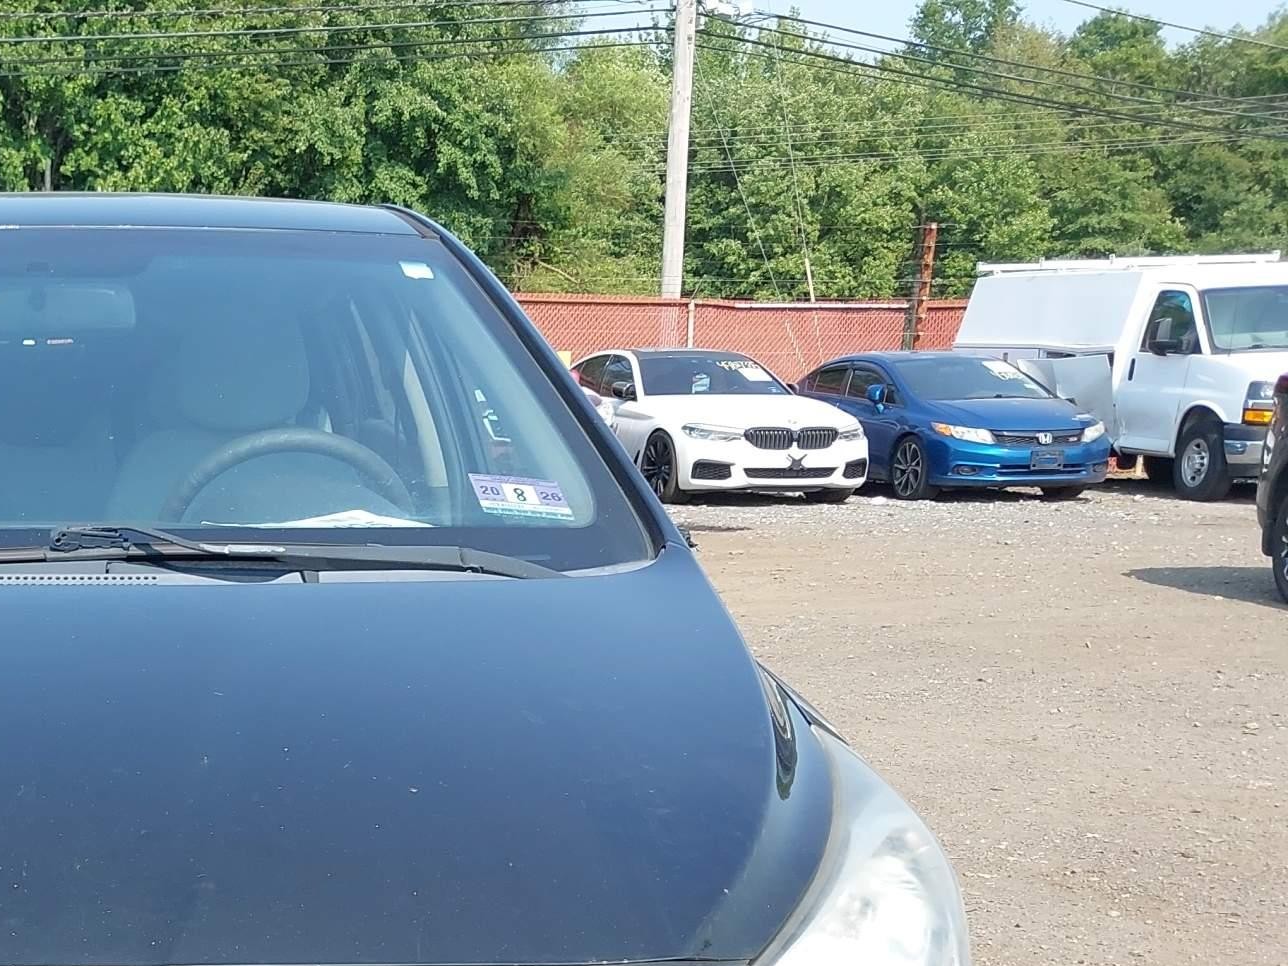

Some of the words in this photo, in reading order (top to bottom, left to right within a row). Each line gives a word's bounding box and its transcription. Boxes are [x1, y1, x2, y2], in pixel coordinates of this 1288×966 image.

[479, 485, 501, 496] 20
[513, 487, 527, 502] 8
[539, 490, 562, 502] 26
